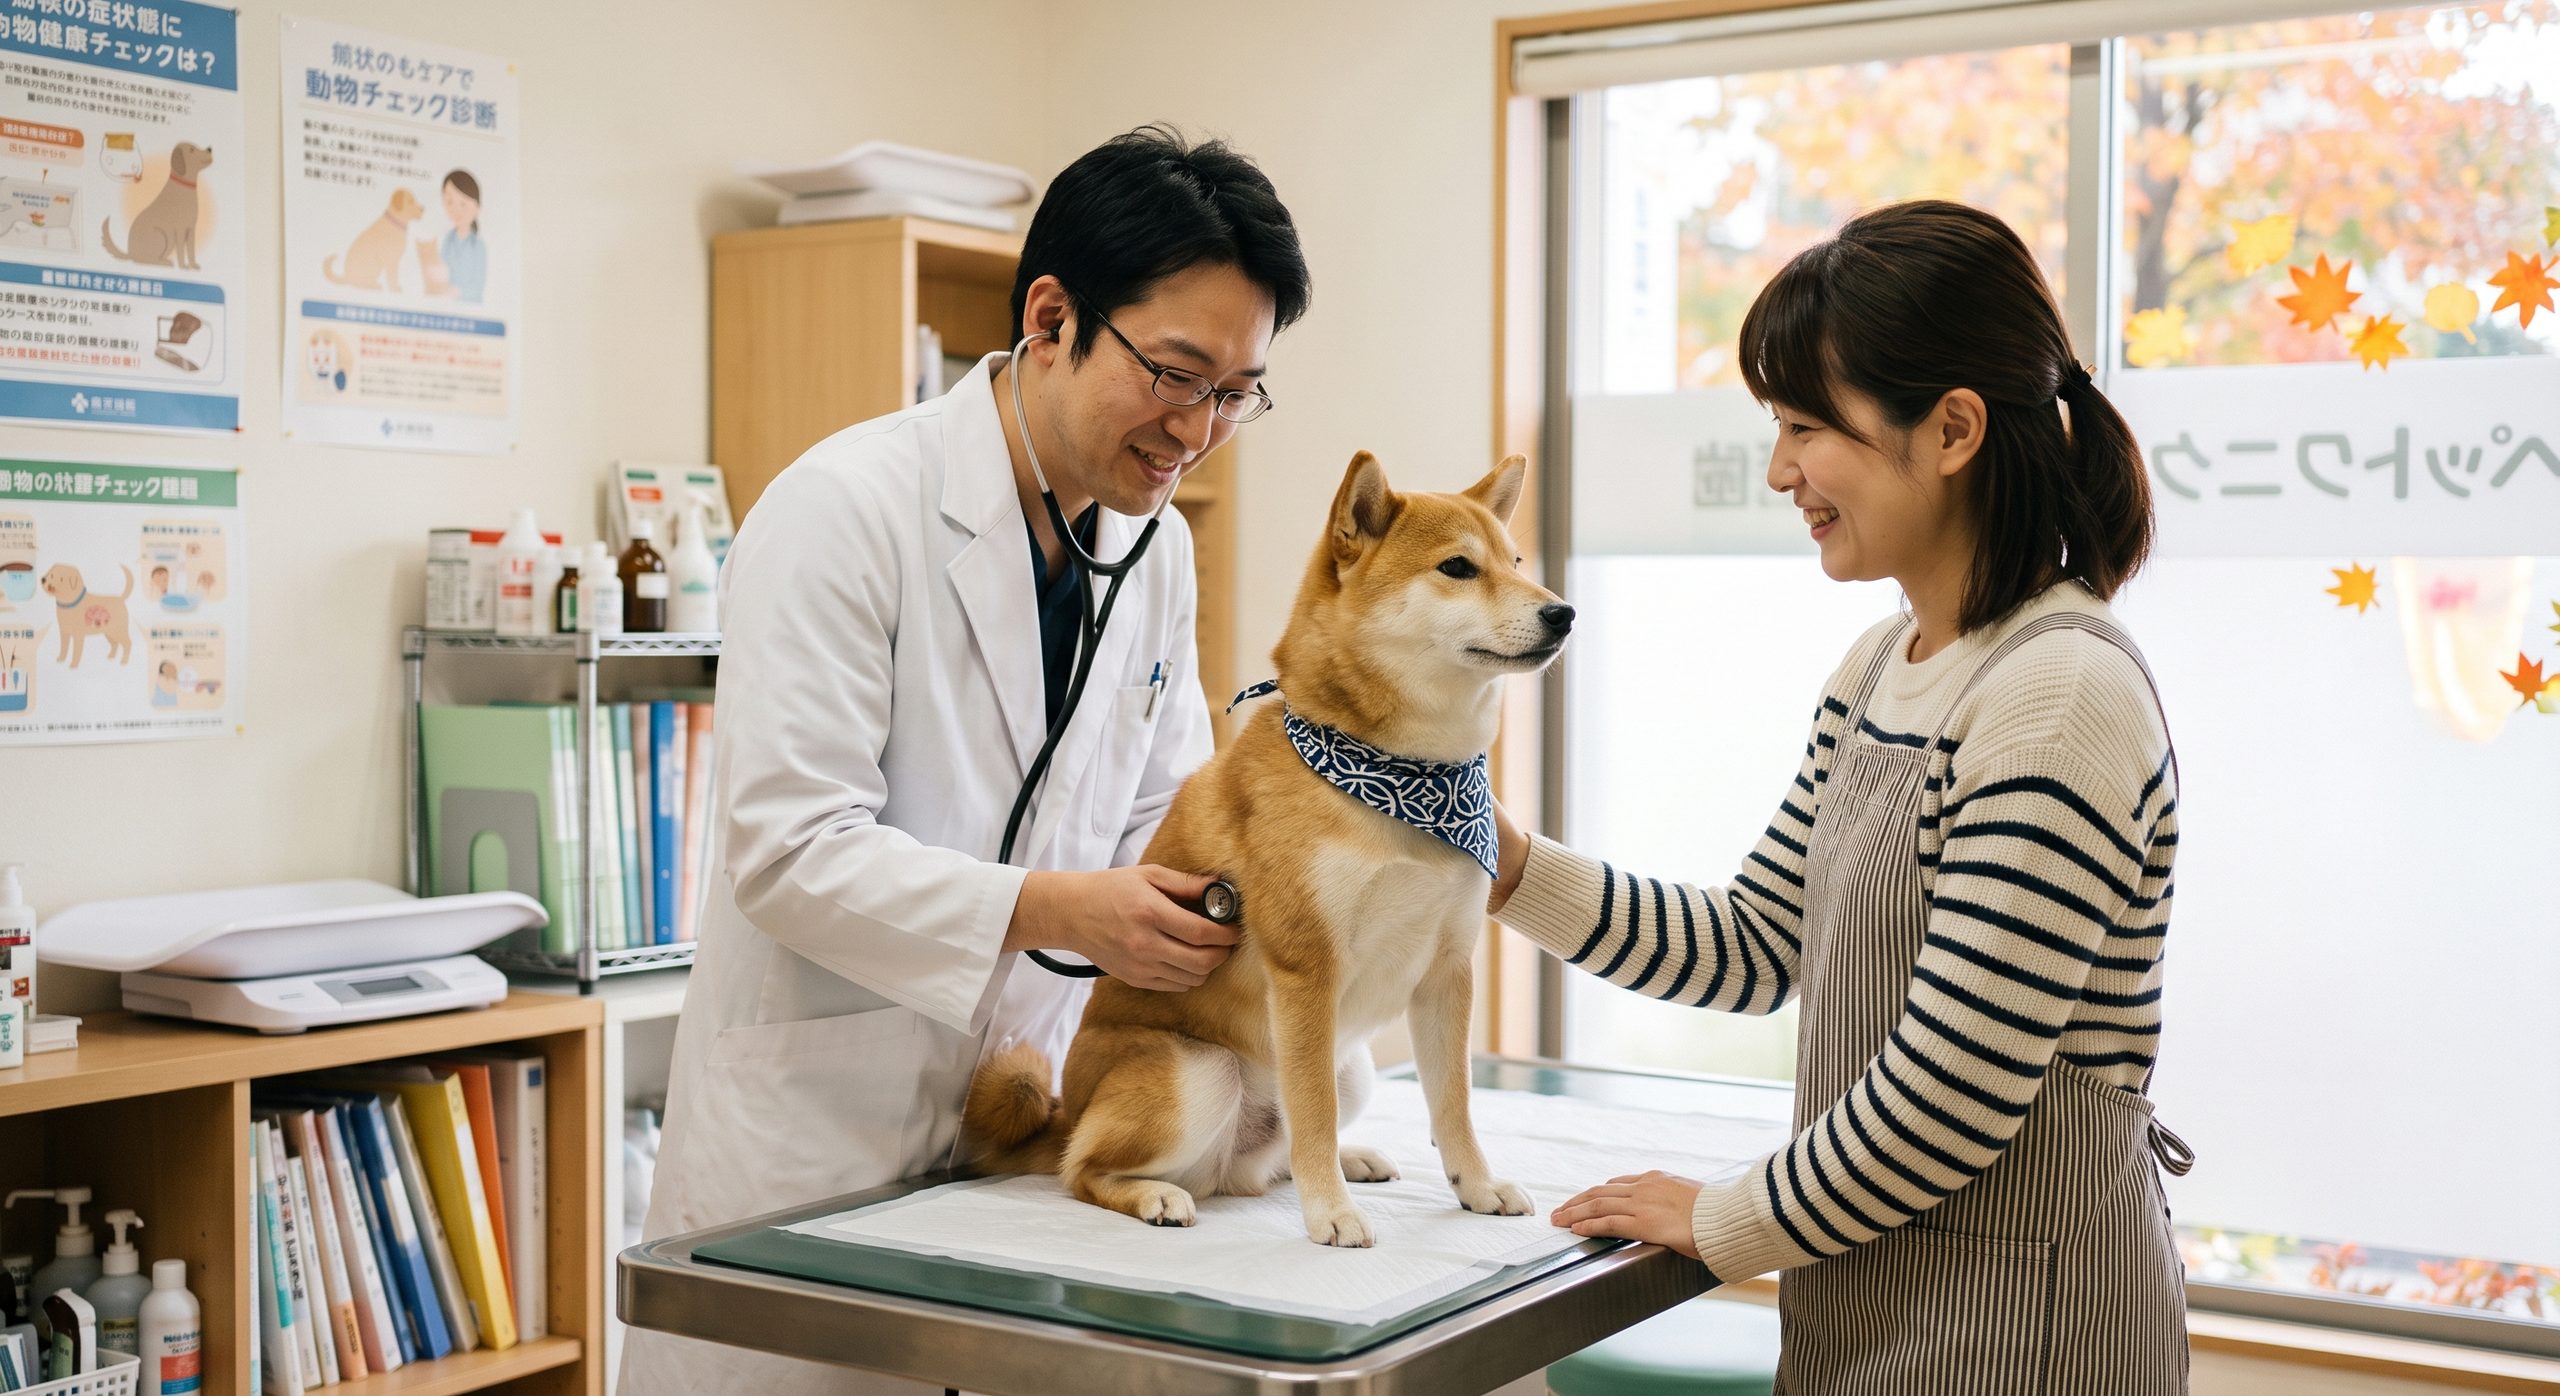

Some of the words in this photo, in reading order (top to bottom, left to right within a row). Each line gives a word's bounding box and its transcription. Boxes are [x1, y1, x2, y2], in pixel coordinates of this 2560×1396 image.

[305, 67, 498, 130] 動物チェック診断
